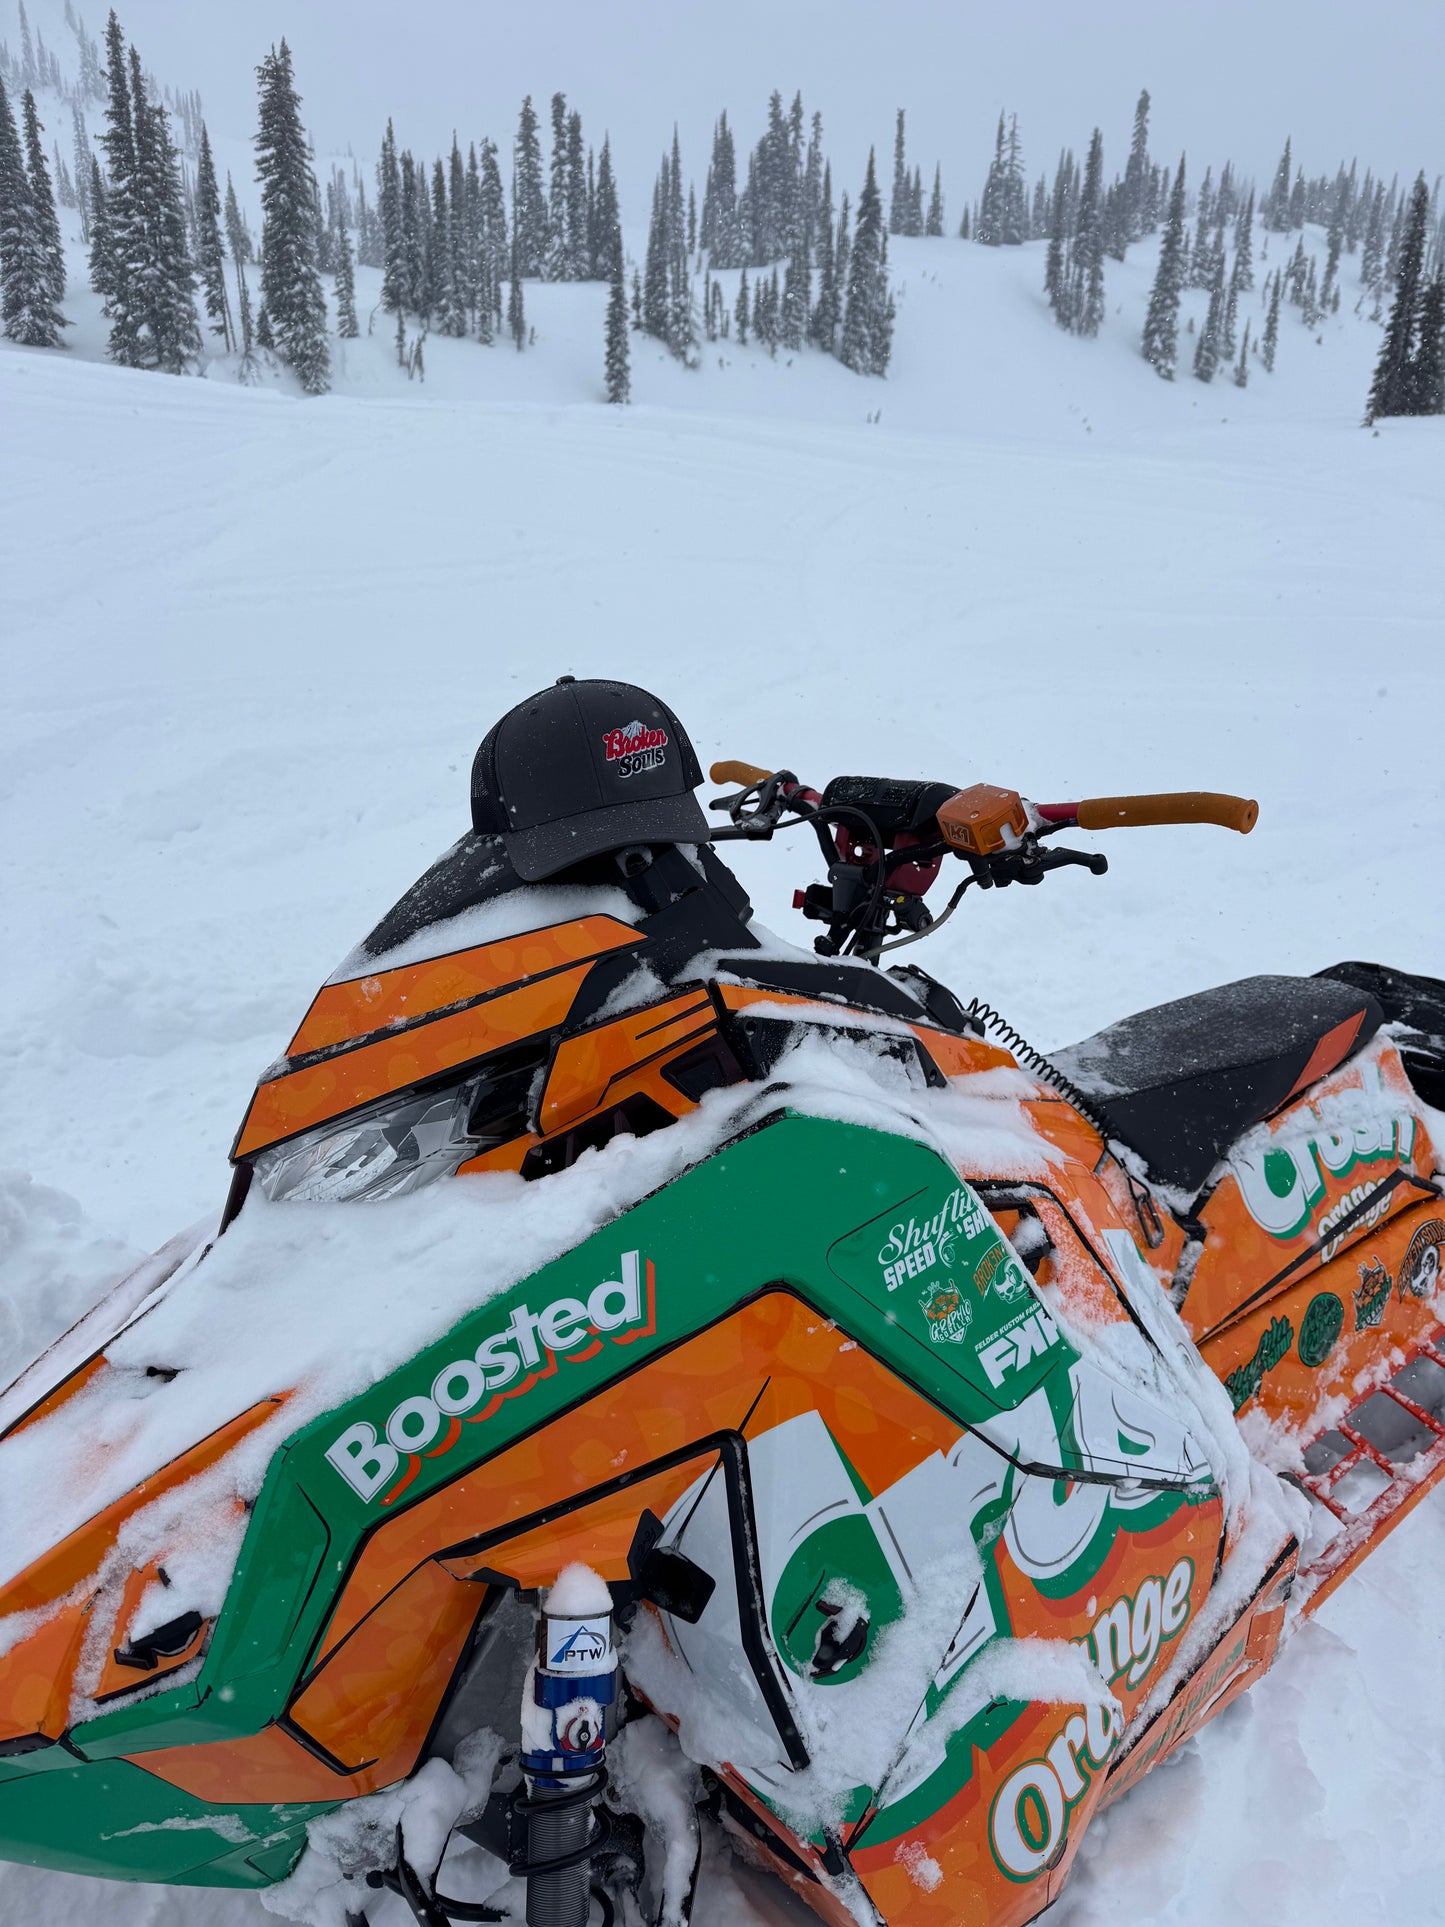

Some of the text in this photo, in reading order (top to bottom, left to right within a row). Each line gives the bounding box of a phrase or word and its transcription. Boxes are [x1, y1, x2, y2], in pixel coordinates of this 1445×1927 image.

[602, 725, 668, 761] Broken
[618, 748, 665, 778] Souls
[883, 1242, 937, 1292] SPEED
[931, 1302, 971, 1341] GRAPHIC
[940, 1315, 971, 1341] GORILLA
[974, 1331, 999, 1352] FELDER
[999, 1312, 1026, 1335] KUSTOM
[323, 1249, 643, 1505] Boosted
[565, 1647, 602, 1661] PTW
